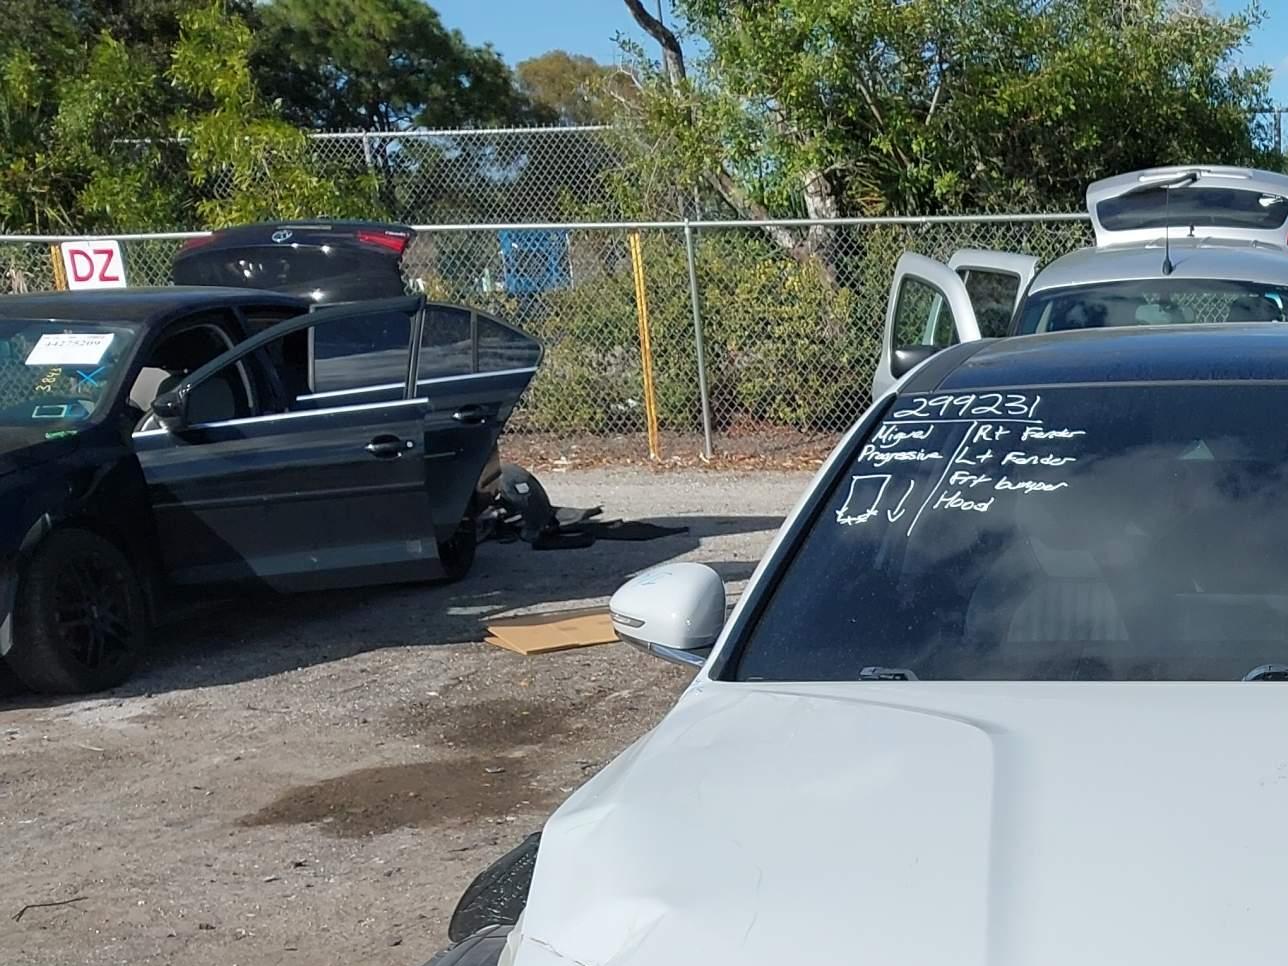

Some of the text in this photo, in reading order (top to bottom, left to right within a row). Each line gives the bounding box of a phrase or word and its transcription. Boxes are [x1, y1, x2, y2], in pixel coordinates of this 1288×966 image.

[68, 249, 120, 282] DZ
[894, 393, 1040, 418] 299231
[1001, 451, 1076, 466] Fender
[933, 490, 994, 512] Hood
